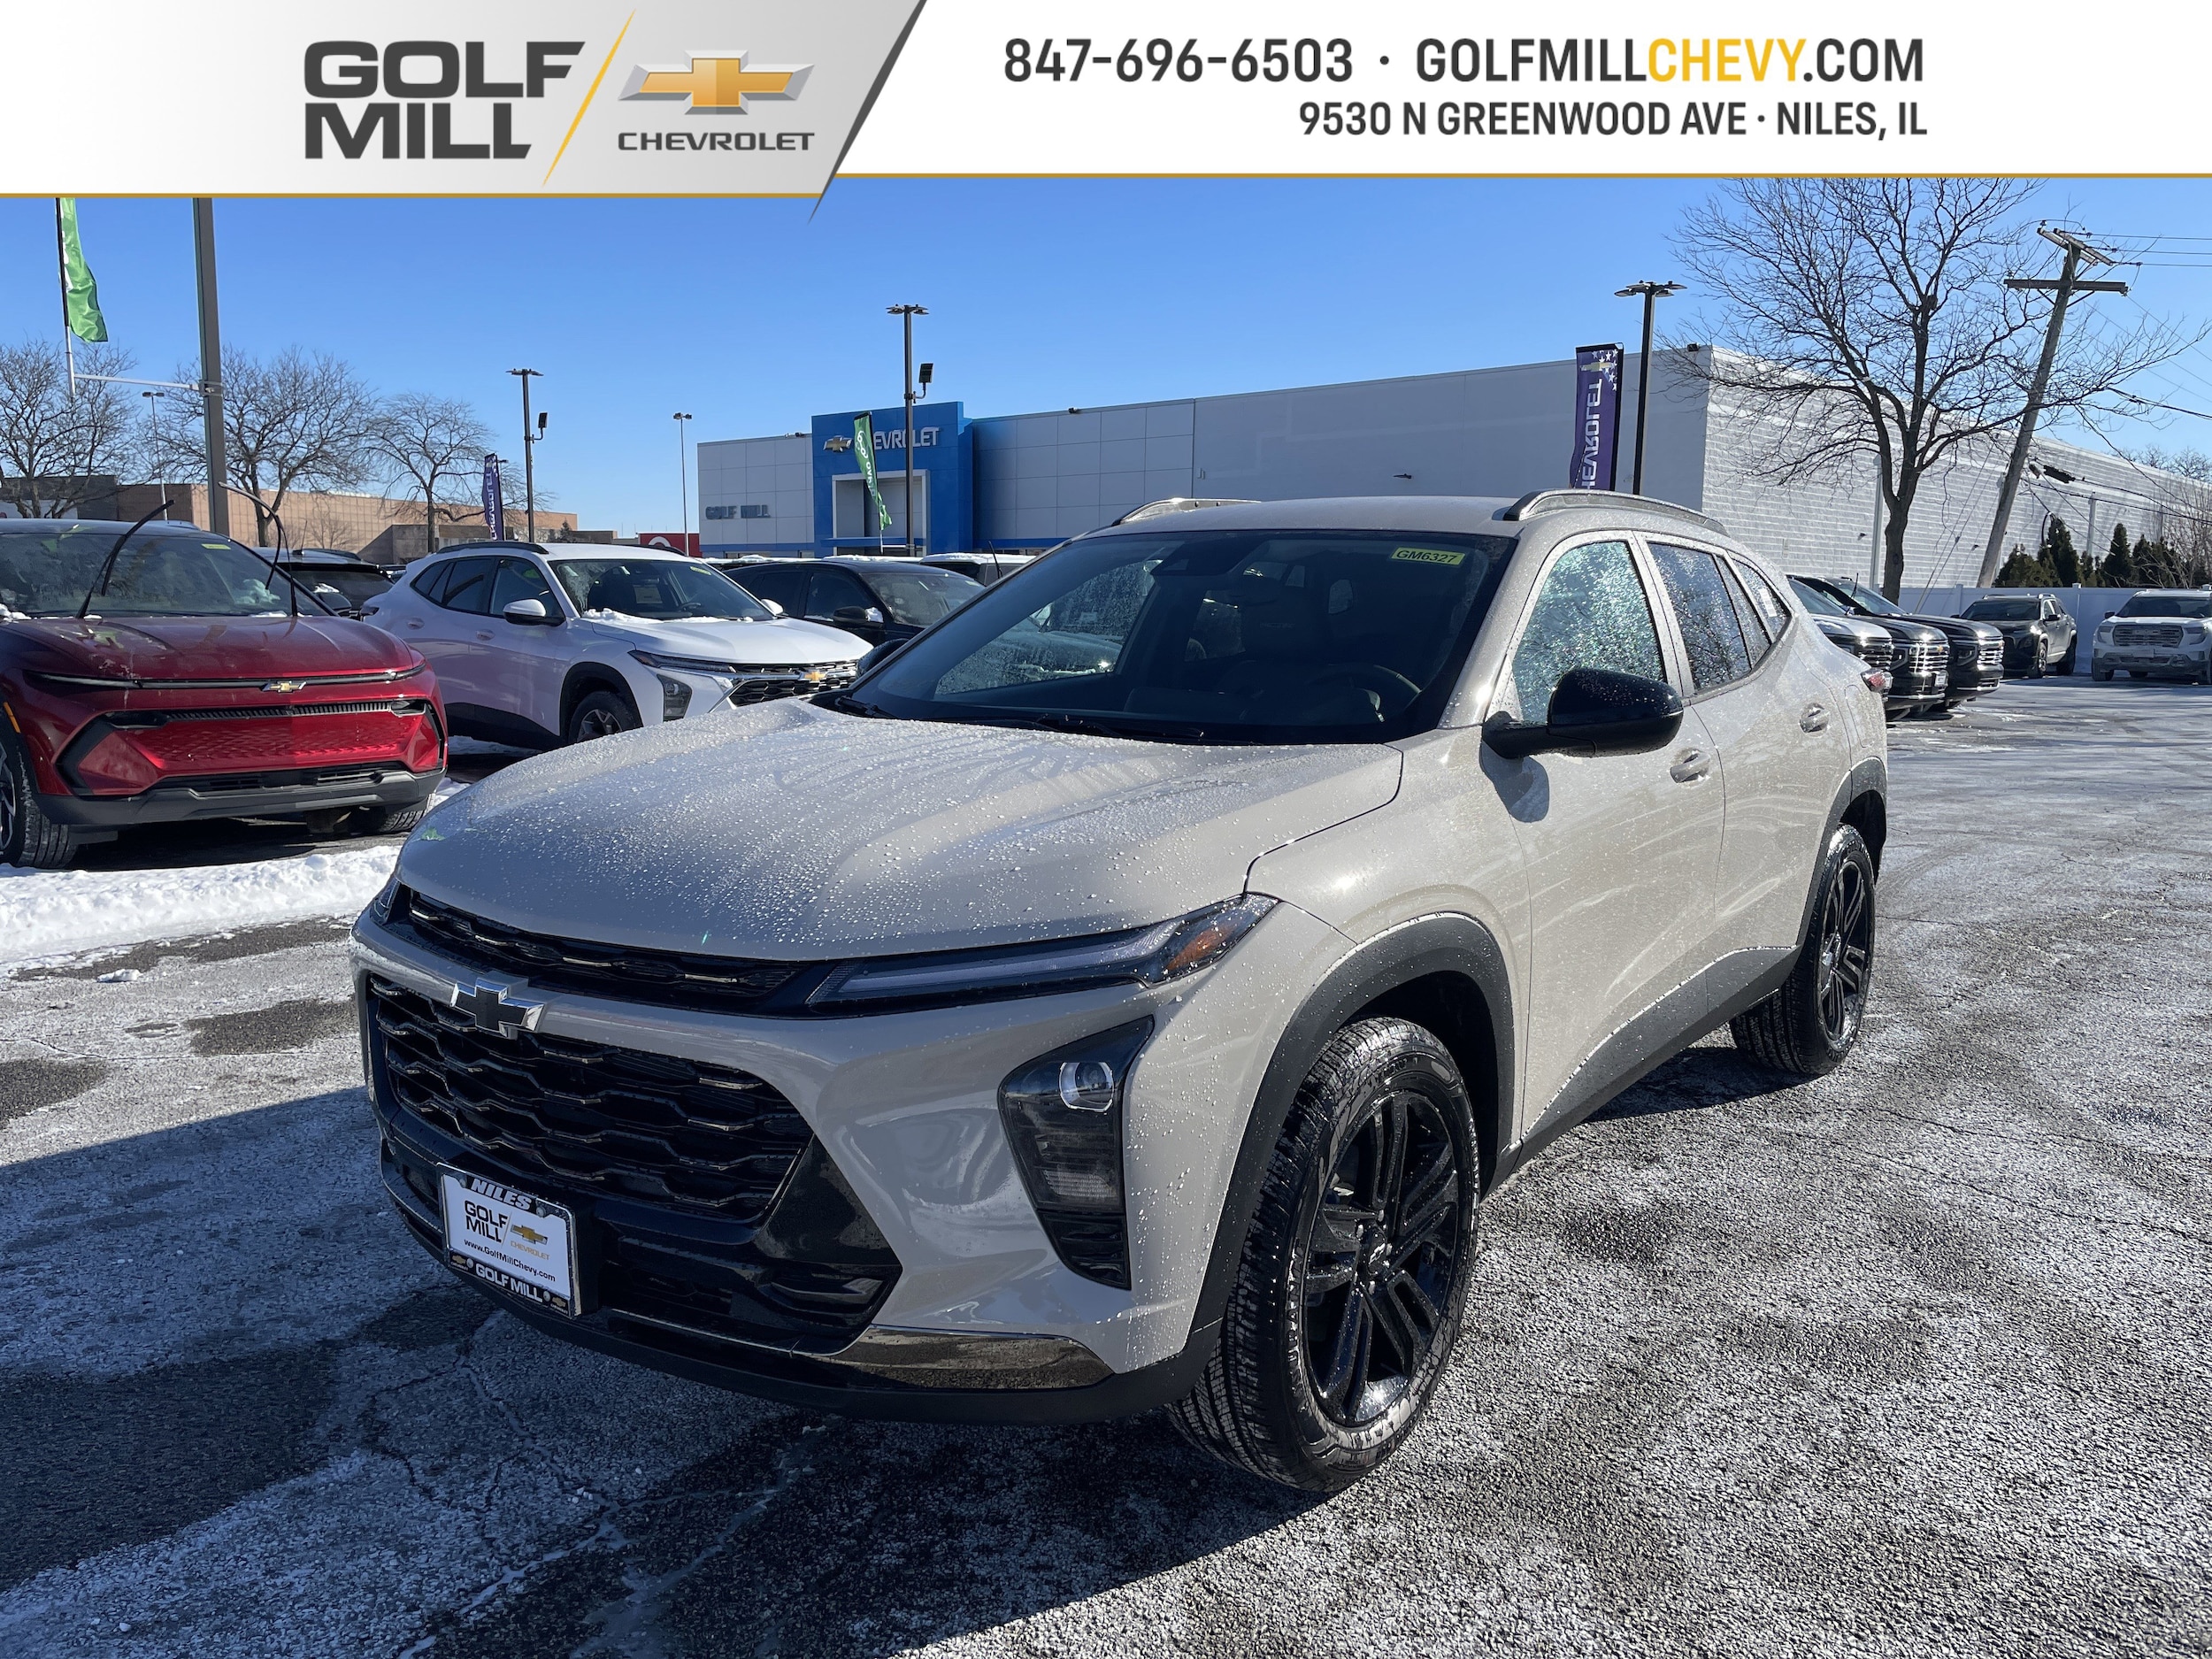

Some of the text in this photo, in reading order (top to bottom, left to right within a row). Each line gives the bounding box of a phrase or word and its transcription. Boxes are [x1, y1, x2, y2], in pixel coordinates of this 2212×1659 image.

[1396, 550, 1457, 564] GM6327
[471, 1178, 532, 1210] NILES
[465, 1201, 508, 1228] GOLF
[466, 1215, 502, 1243] MILL
[464, 1239, 556, 1282] www.GolfMillChevy.com
[511, 1240, 549, 1260] CHEVROLET
[475, 1263, 509, 1287] GOLF
[511, 1278, 542, 1302] MILL
